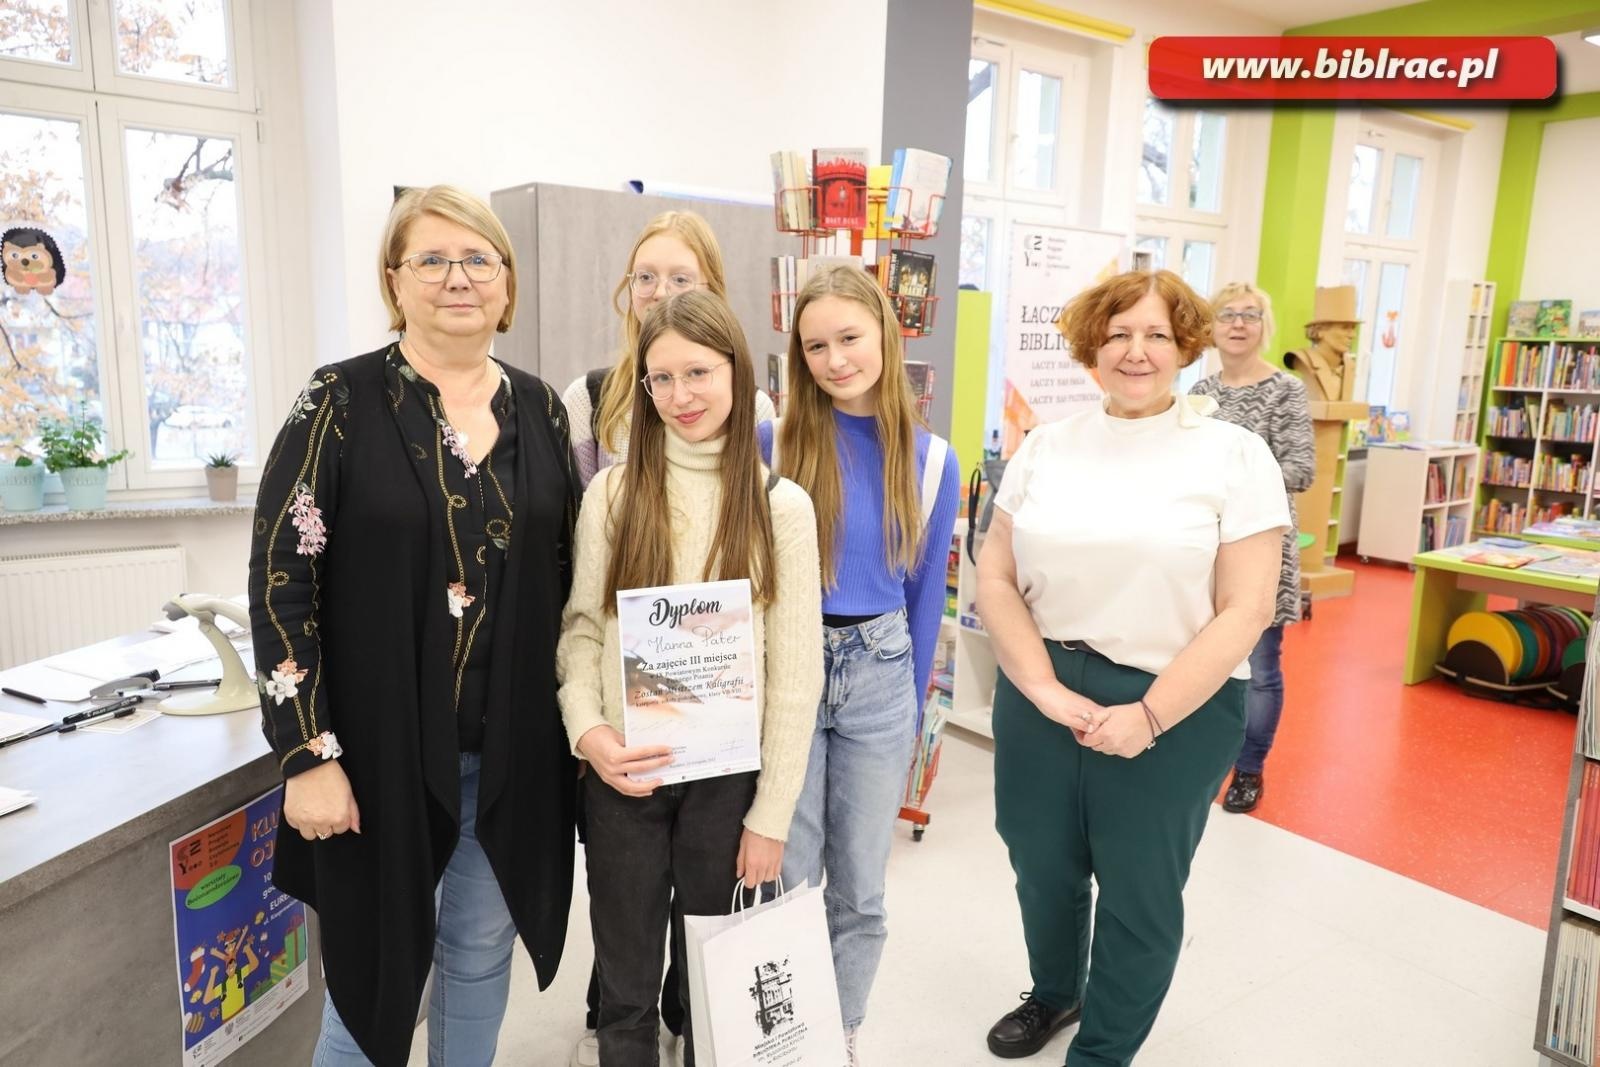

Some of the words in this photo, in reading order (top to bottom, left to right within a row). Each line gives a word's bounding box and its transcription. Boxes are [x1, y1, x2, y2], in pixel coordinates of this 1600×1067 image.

[649, 598, 722, 629] Dyplom
[642, 661, 654, 671] Za
[656, 657, 688, 670] zajęcie
[690, 655, 701, 665] III
[703, 652, 737, 664] miejsca
[251, 808, 280, 842] KLU
[270, 893, 290, 910] EURE
